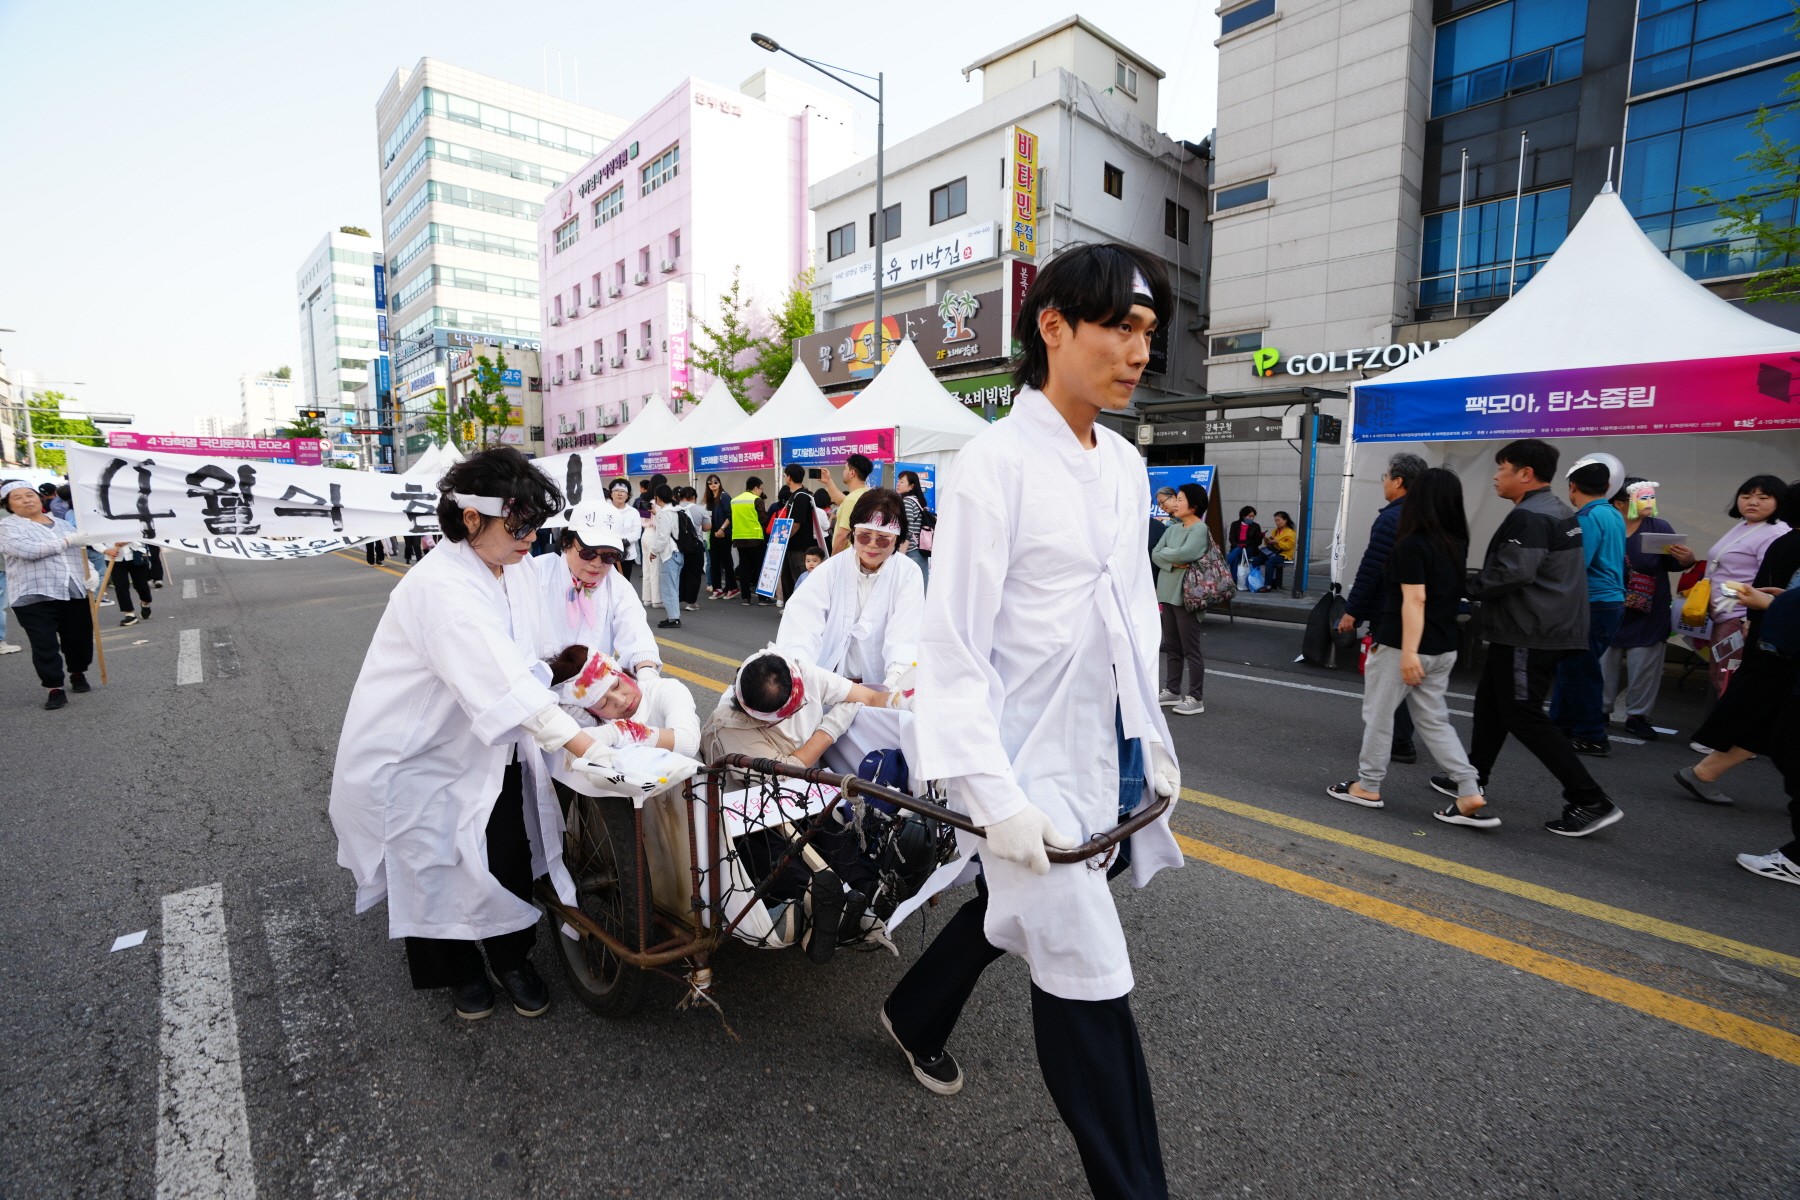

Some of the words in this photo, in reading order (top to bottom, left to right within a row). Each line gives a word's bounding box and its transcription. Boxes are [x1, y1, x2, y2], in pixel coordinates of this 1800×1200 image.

[1016, 131, 1034, 220] 비타민
[1013, 220, 1033, 242] 주점
[910, 238, 961, 271] 미박집
[1019, 241, 1028, 253] B1
[936, 349, 947, 360] 2F
[1286, 341, 1432, 377] GOLFZON
[1465, 392, 1540, 416] 팩모아,
[1548, 385, 1657, 413] 탄소중립
[1205, 422, 1232, 432] 강북구청
[199, 439, 257, 450] 국민문화제
[258, 440, 291, 450] 2024
[792, 446, 826, 458] 문자알림신청
[831, 444, 858, 455] SNS구독
[859, 443, 879, 454] 이벤트
